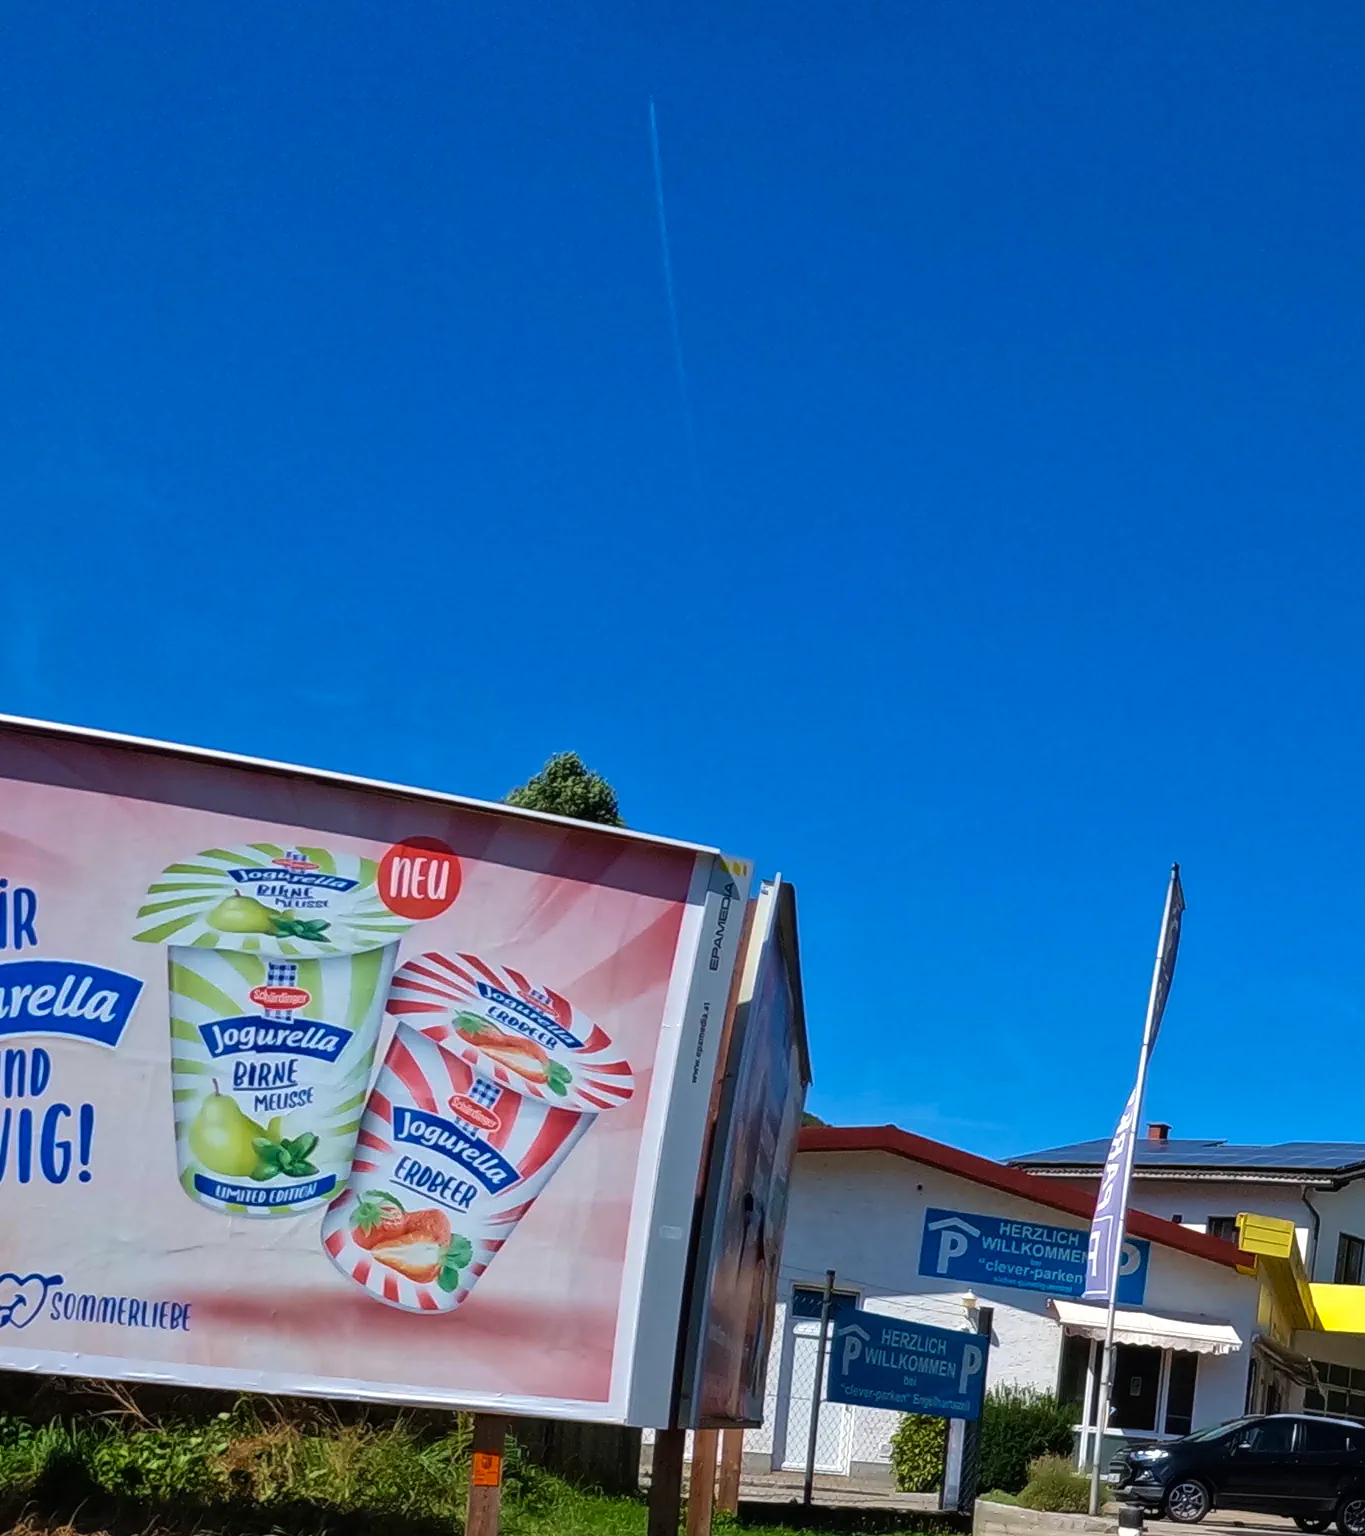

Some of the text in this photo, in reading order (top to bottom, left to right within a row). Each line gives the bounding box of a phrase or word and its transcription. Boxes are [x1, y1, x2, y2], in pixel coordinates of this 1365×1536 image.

[389, 856, 450, 900] NEU
[708, 881, 735, 972] EPAMEDIA
[212, 1024, 340, 1054] Jogurella
[233, 1058, 299, 1088] BIRNE
[397, 1111, 508, 1185] Jogurella
[215, 1181, 318, 1204] LIMITED EDITION
[394, 1155, 478, 1209] ERDBEER
[1000, 1222, 1080, 1246] HERZLICH
[50, 1291, 193, 1332] SOMMERLIEBE
[880, 1328, 948, 1356] HERZLICH
[865, 1346, 957, 1379] WILLKOMMEN
